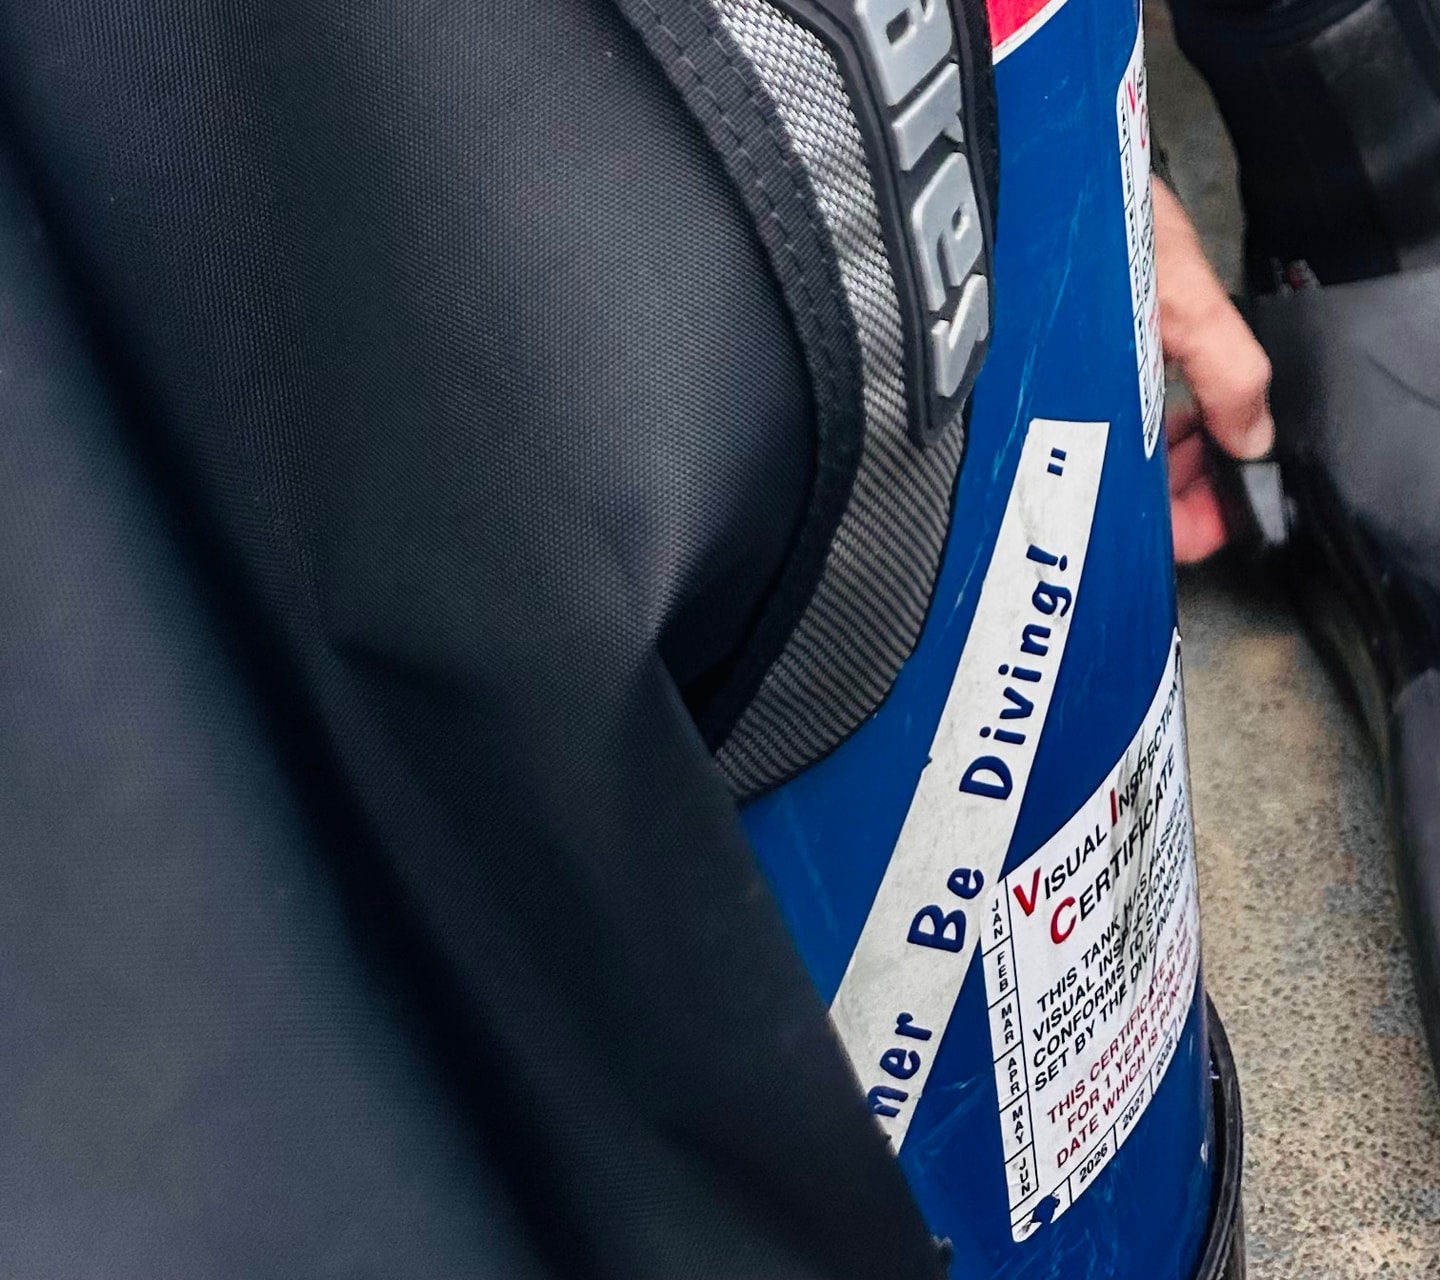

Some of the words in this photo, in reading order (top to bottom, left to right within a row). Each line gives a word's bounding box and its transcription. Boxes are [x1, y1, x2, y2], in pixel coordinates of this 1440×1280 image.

[907, 866, 986, 955] Be
[958, 544, 1073, 801] Diving!
[1013, 824, 1108, 917] VISUAL
[1050, 743, 1176, 945] CERTIFICATE
[991, 897, 1004, 940] JAN
[996, 951, 1009, 991] FEB
[1033, 959, 1126, 1068] CONFORMS
[1129, 930, 1144, 961] TO
[1037, 967, 1078, 1013] THIS
[1081, 914, 1121, 969] TANK
[1001, 1004, 1014, 1045] MAR
[1033, 976, 1095, 1042] VISUAL
[1035, 1047, 1069, 1092] SET
[1075, 1019, 1096, 1056] BY
[1099, 979, 1127, 1023] THE
[1130, 932, 1157, 984] DIVE
[1047, 1079, 1086, 1125] THIS
[1089, 959, 1166, 1081] CERTIFICATE
[1007, 1057, 1021, 1097] APR
[1056, 1112, 1099, 1169] DATE
[1103, 1052, 1145, 1116] WHICH
[1149, 1026, 1159, 1053] IS
[1067, 1090, 1101, 1133] FOR
[1104, 1074, 1111, 1092] 1
[1115, 1024, 1149, 1073] YEAR
[1121, 1090, 1146, 1132] 2027
[1012, 1104, 1025, 1146] MAY
[1079, 1142, 1109, 1184] 2026
[1018, 1156, 1031, 1197] JUN
